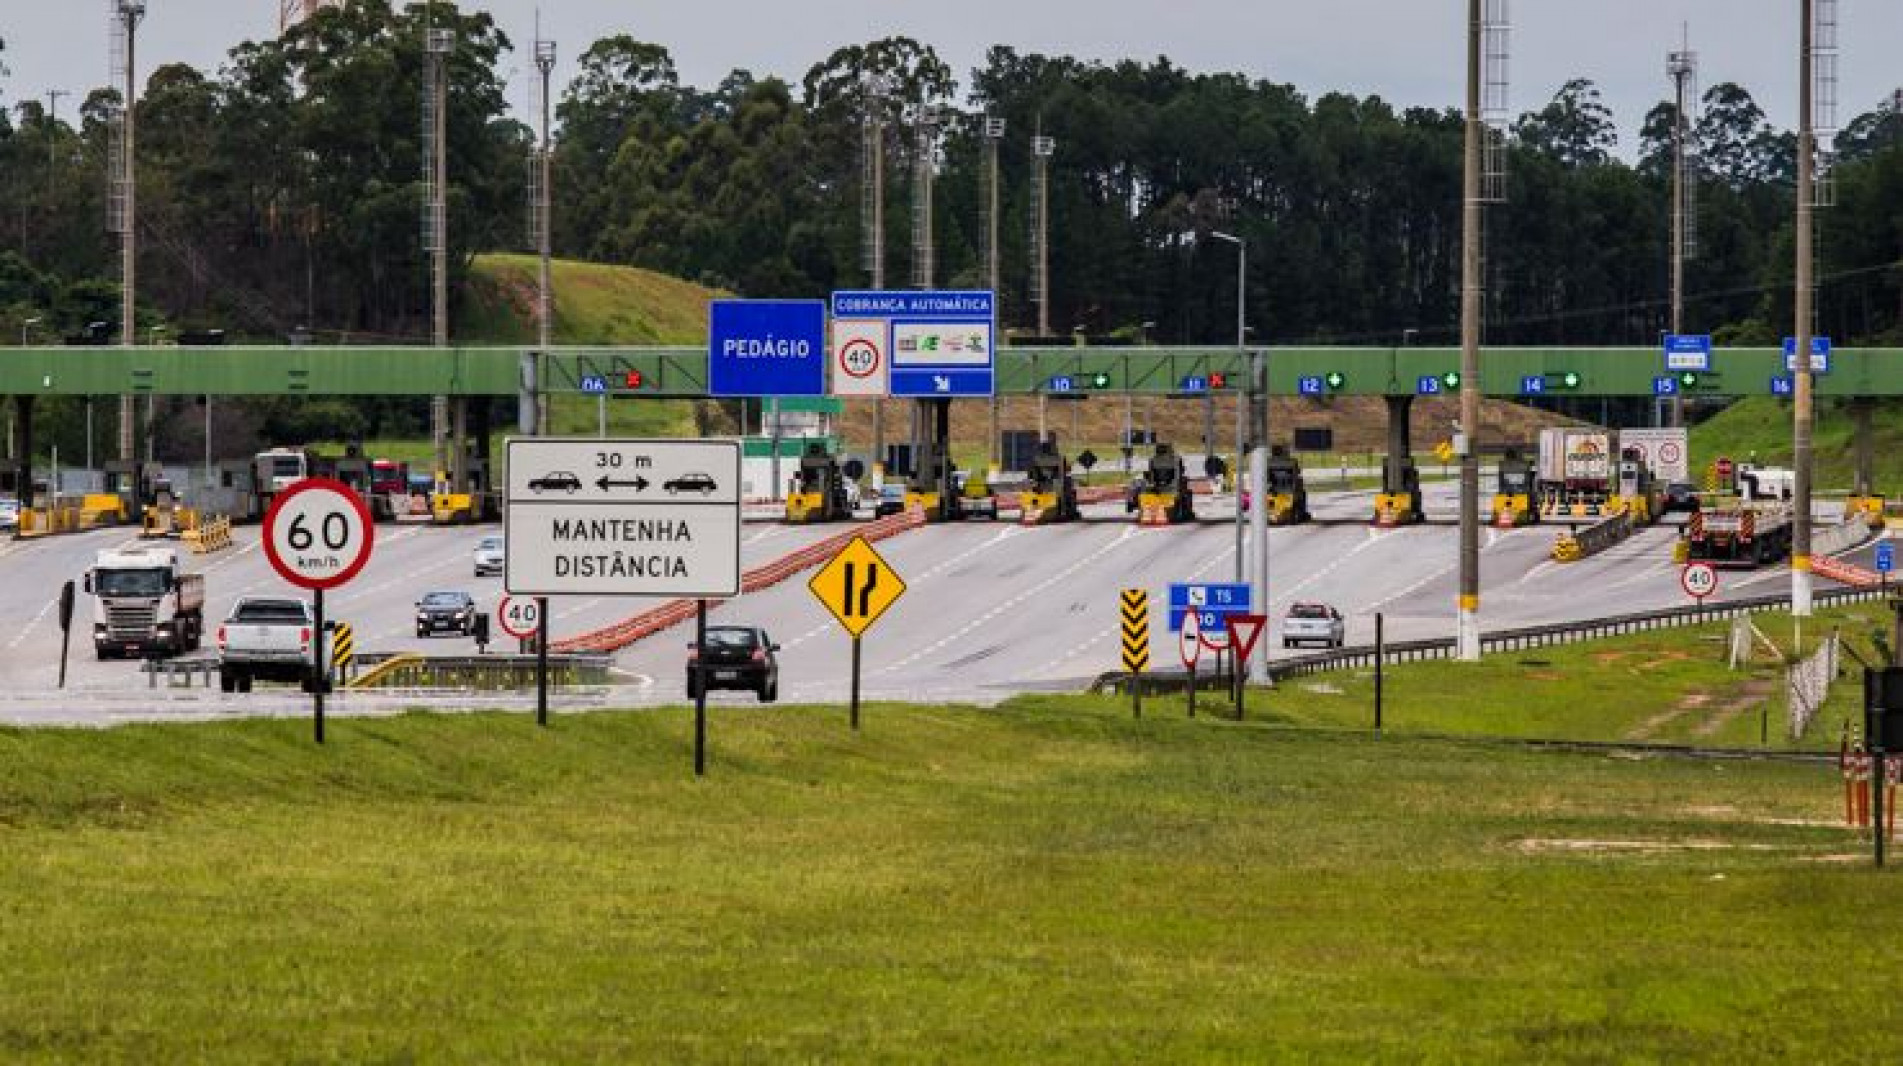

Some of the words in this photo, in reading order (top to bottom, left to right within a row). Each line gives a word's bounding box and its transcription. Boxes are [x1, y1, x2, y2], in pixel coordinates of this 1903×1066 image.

[836, 298, 907, 312] COBRANÇA
[911, 296, 989, 310] AUTOMÁTICA
[723, 334, 810, 358] PEDÁGIO
[849, 349, 872, 364] 40
[1302, 378, 1319, 392] 12
[1421, 378, 1438, 392] 13
[1526, 378, 1541, 392] 14
[595, 452, 622, 468] 30
[635, 455, 653, 468] m
[288, 511, 349, 551] 60
[553, 519, 691, 541] MANTENHA
[297, 556, 339, 568] km/h
[555, 551, 688, 577] DISTÂNCIA
[1688, 571, 1711, 585] 40
[508, 604, 537, 621] 40
